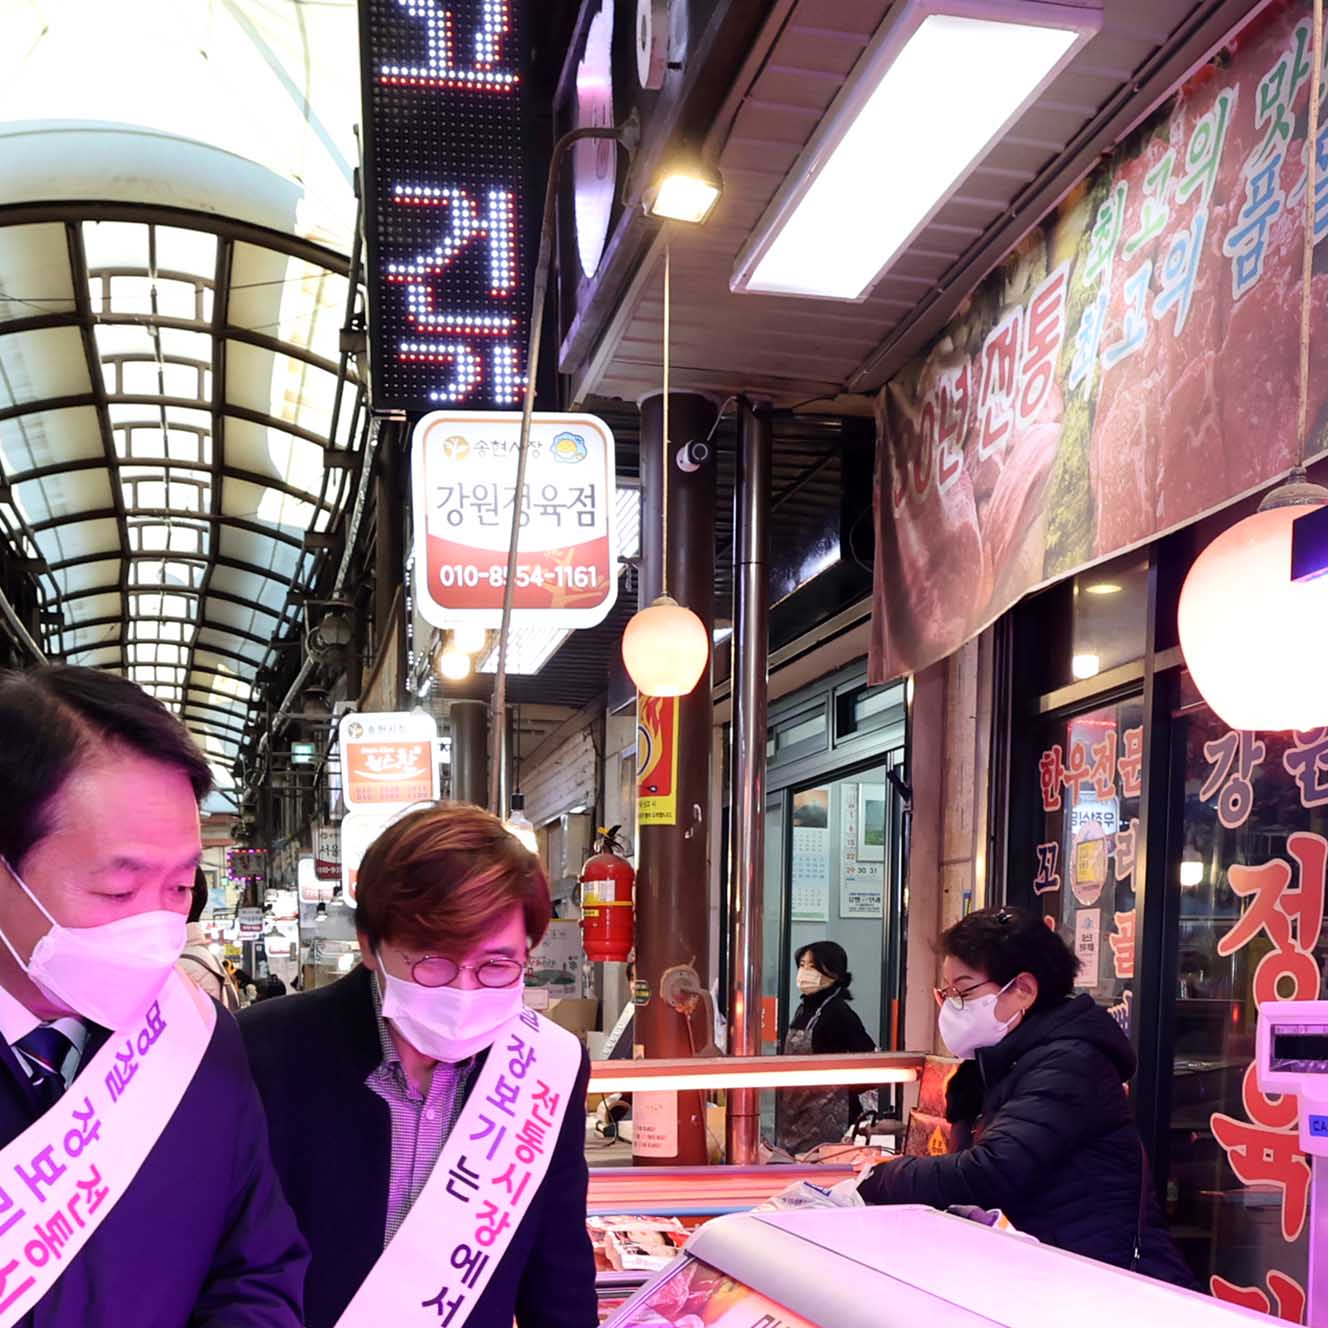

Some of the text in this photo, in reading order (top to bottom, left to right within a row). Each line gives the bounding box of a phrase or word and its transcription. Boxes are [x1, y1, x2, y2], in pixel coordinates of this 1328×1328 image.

[1083, 86, 1235, 296] 최고의
[977, 272, 1068, 462] 전통
[1067, 210, 1209, 396] 최고의
[436, 481, 597, 528] 강원정육점
[439, 564, 598, 588] 010-854-1161
[1039, 725, 1144, 812] 한우전문
[446, 1033, 539, 1203] 장보기는
